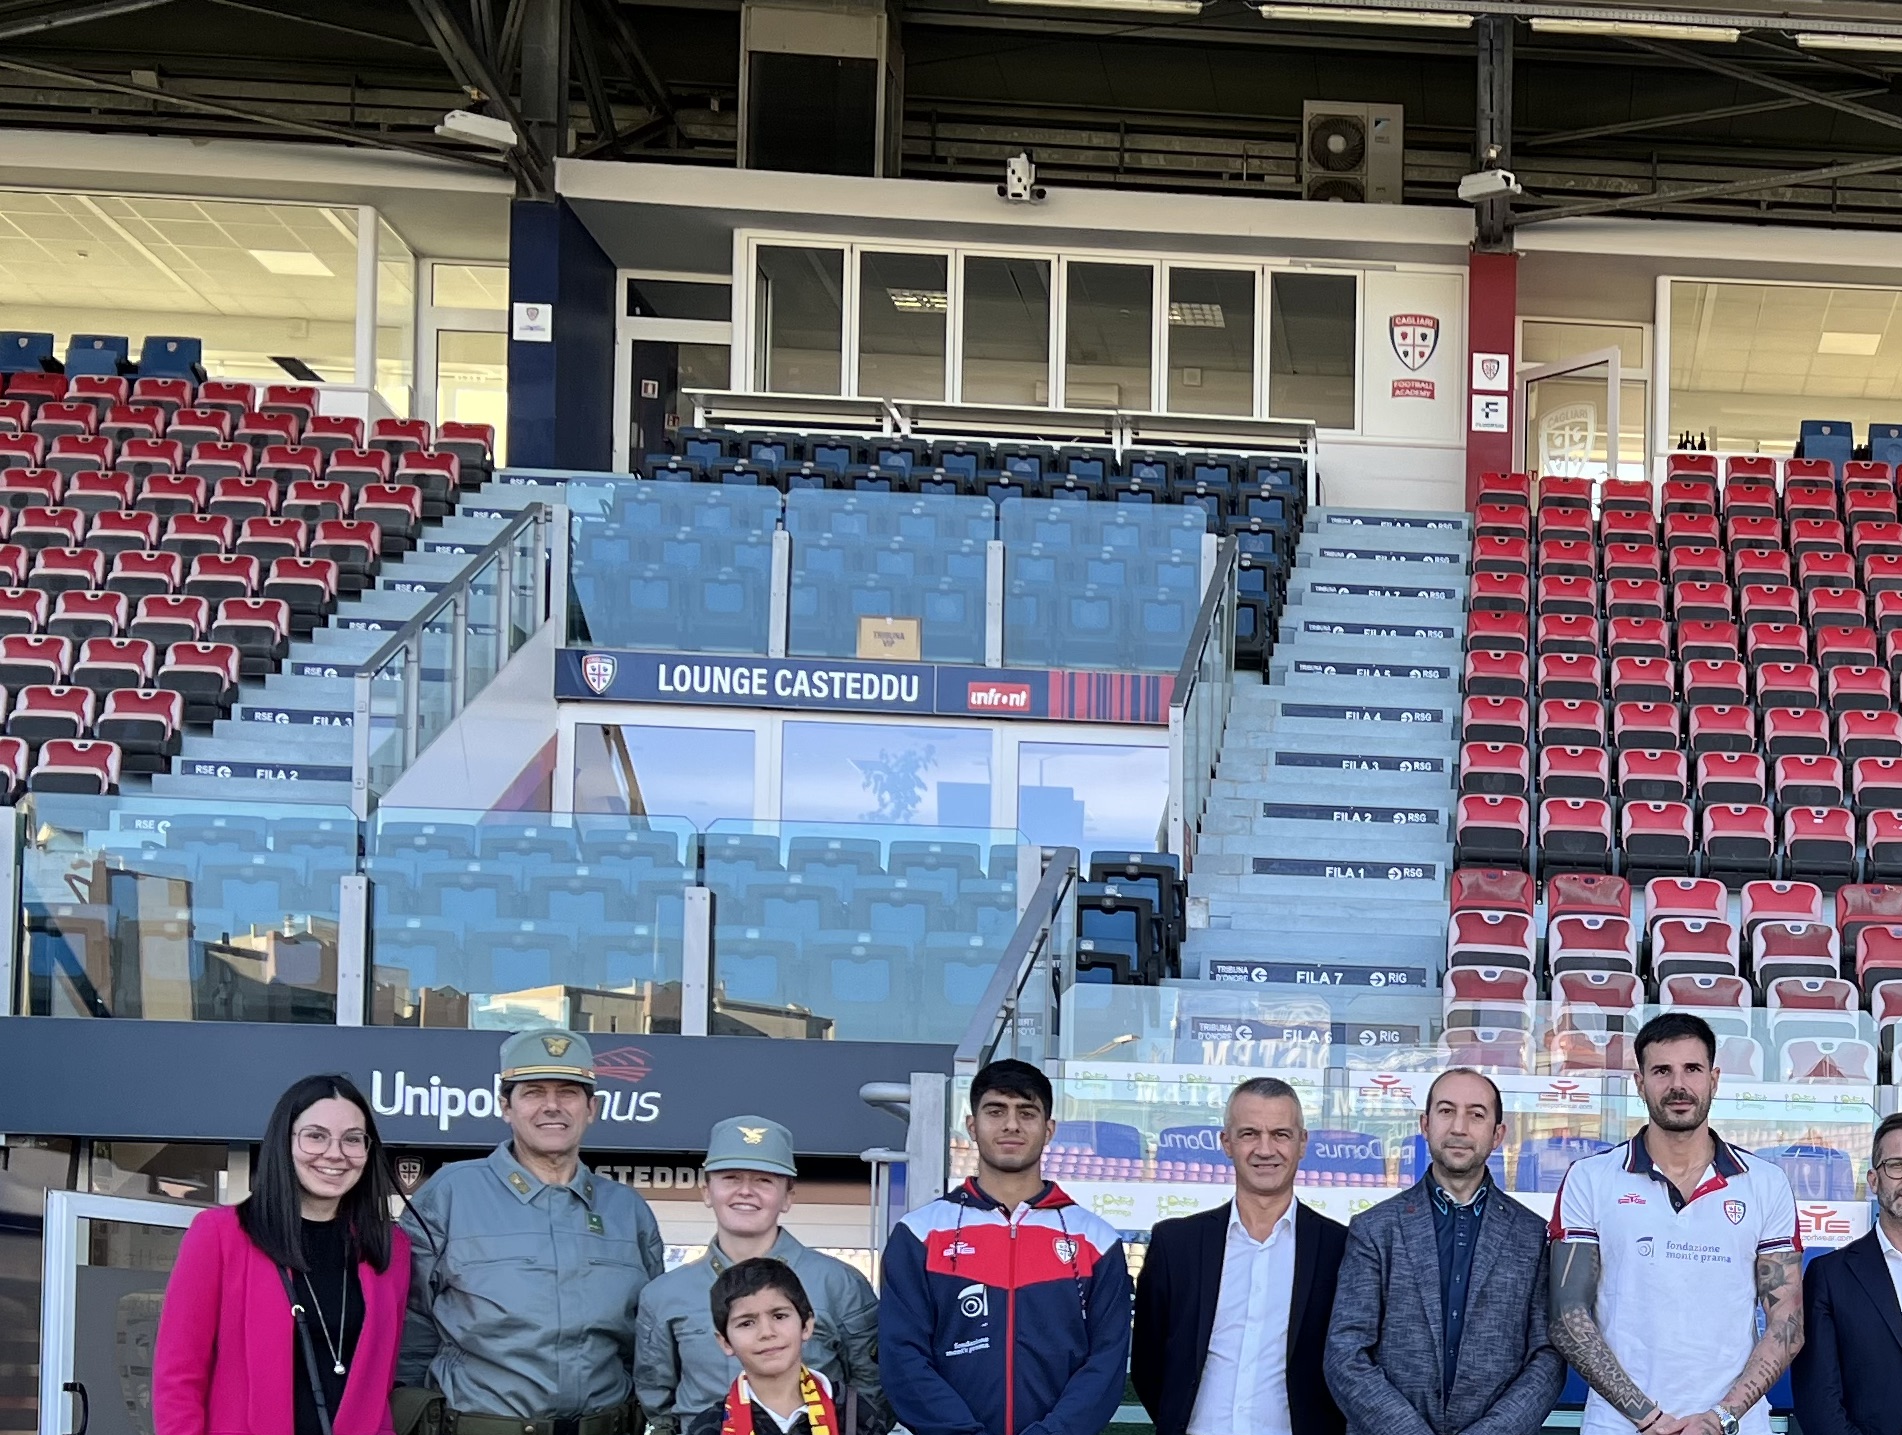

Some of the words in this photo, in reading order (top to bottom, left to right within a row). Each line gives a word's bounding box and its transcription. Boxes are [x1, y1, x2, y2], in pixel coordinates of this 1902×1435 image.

[1395, 317, 1433, 327] CAGLIARI
[1393, 381, 1433, 390] FOOTBALL
[1394, 389, 1432, 398] ACADEMY
[1427, 630, 1443, 638] RSG
[304, 667, 322, 676] RSE
[1422, 670, 1440, 678] RSG
[658, 664, 768, 695] LOUNGE
[775, 669, 919, 702] CASTEDDU
[971, 688, 1027, 707] infront
[255, 712, 273, 721] RSE
[1414, 713, 1432, 722] RSG
[1414, 762, 1432, 771] RSG
[195, 765, 215, 775] RSE
[256, 768, 286, 780] FILA
[289, 770, 298, 780] 2
[1333, 811, 1361, 822] FILA
[1364, 813, 1372, 823] 2
[1407, 813, 1426, 822] RSG
[135, 820, 155, 830] RSE
[1325, 867, 1354, 878] FILA
[1358, 868, 1365, 879] 1
[1403, 868, 1423, 878] RSG
[1216, 965, 1248, 974] TRIBUNA
[1296, 971, 1331, 985] FILA
[1334, 972, 1343, 985] 7
[1388, 972, 1407, 983] RIG
[1199, 1023, 1233, 1032] TRIBUNA
[1283, 1029, 1320, 1043] FILA
[1324, 1031, 1332, 1043] 6
[1380, 1031, 1400, 1042] RIG
[1666, 1240, 1720, 1253] fondazione
[1665, 1251, 1698, 1261] mont'e
[1700, 1254, 1731, 1263] prama
